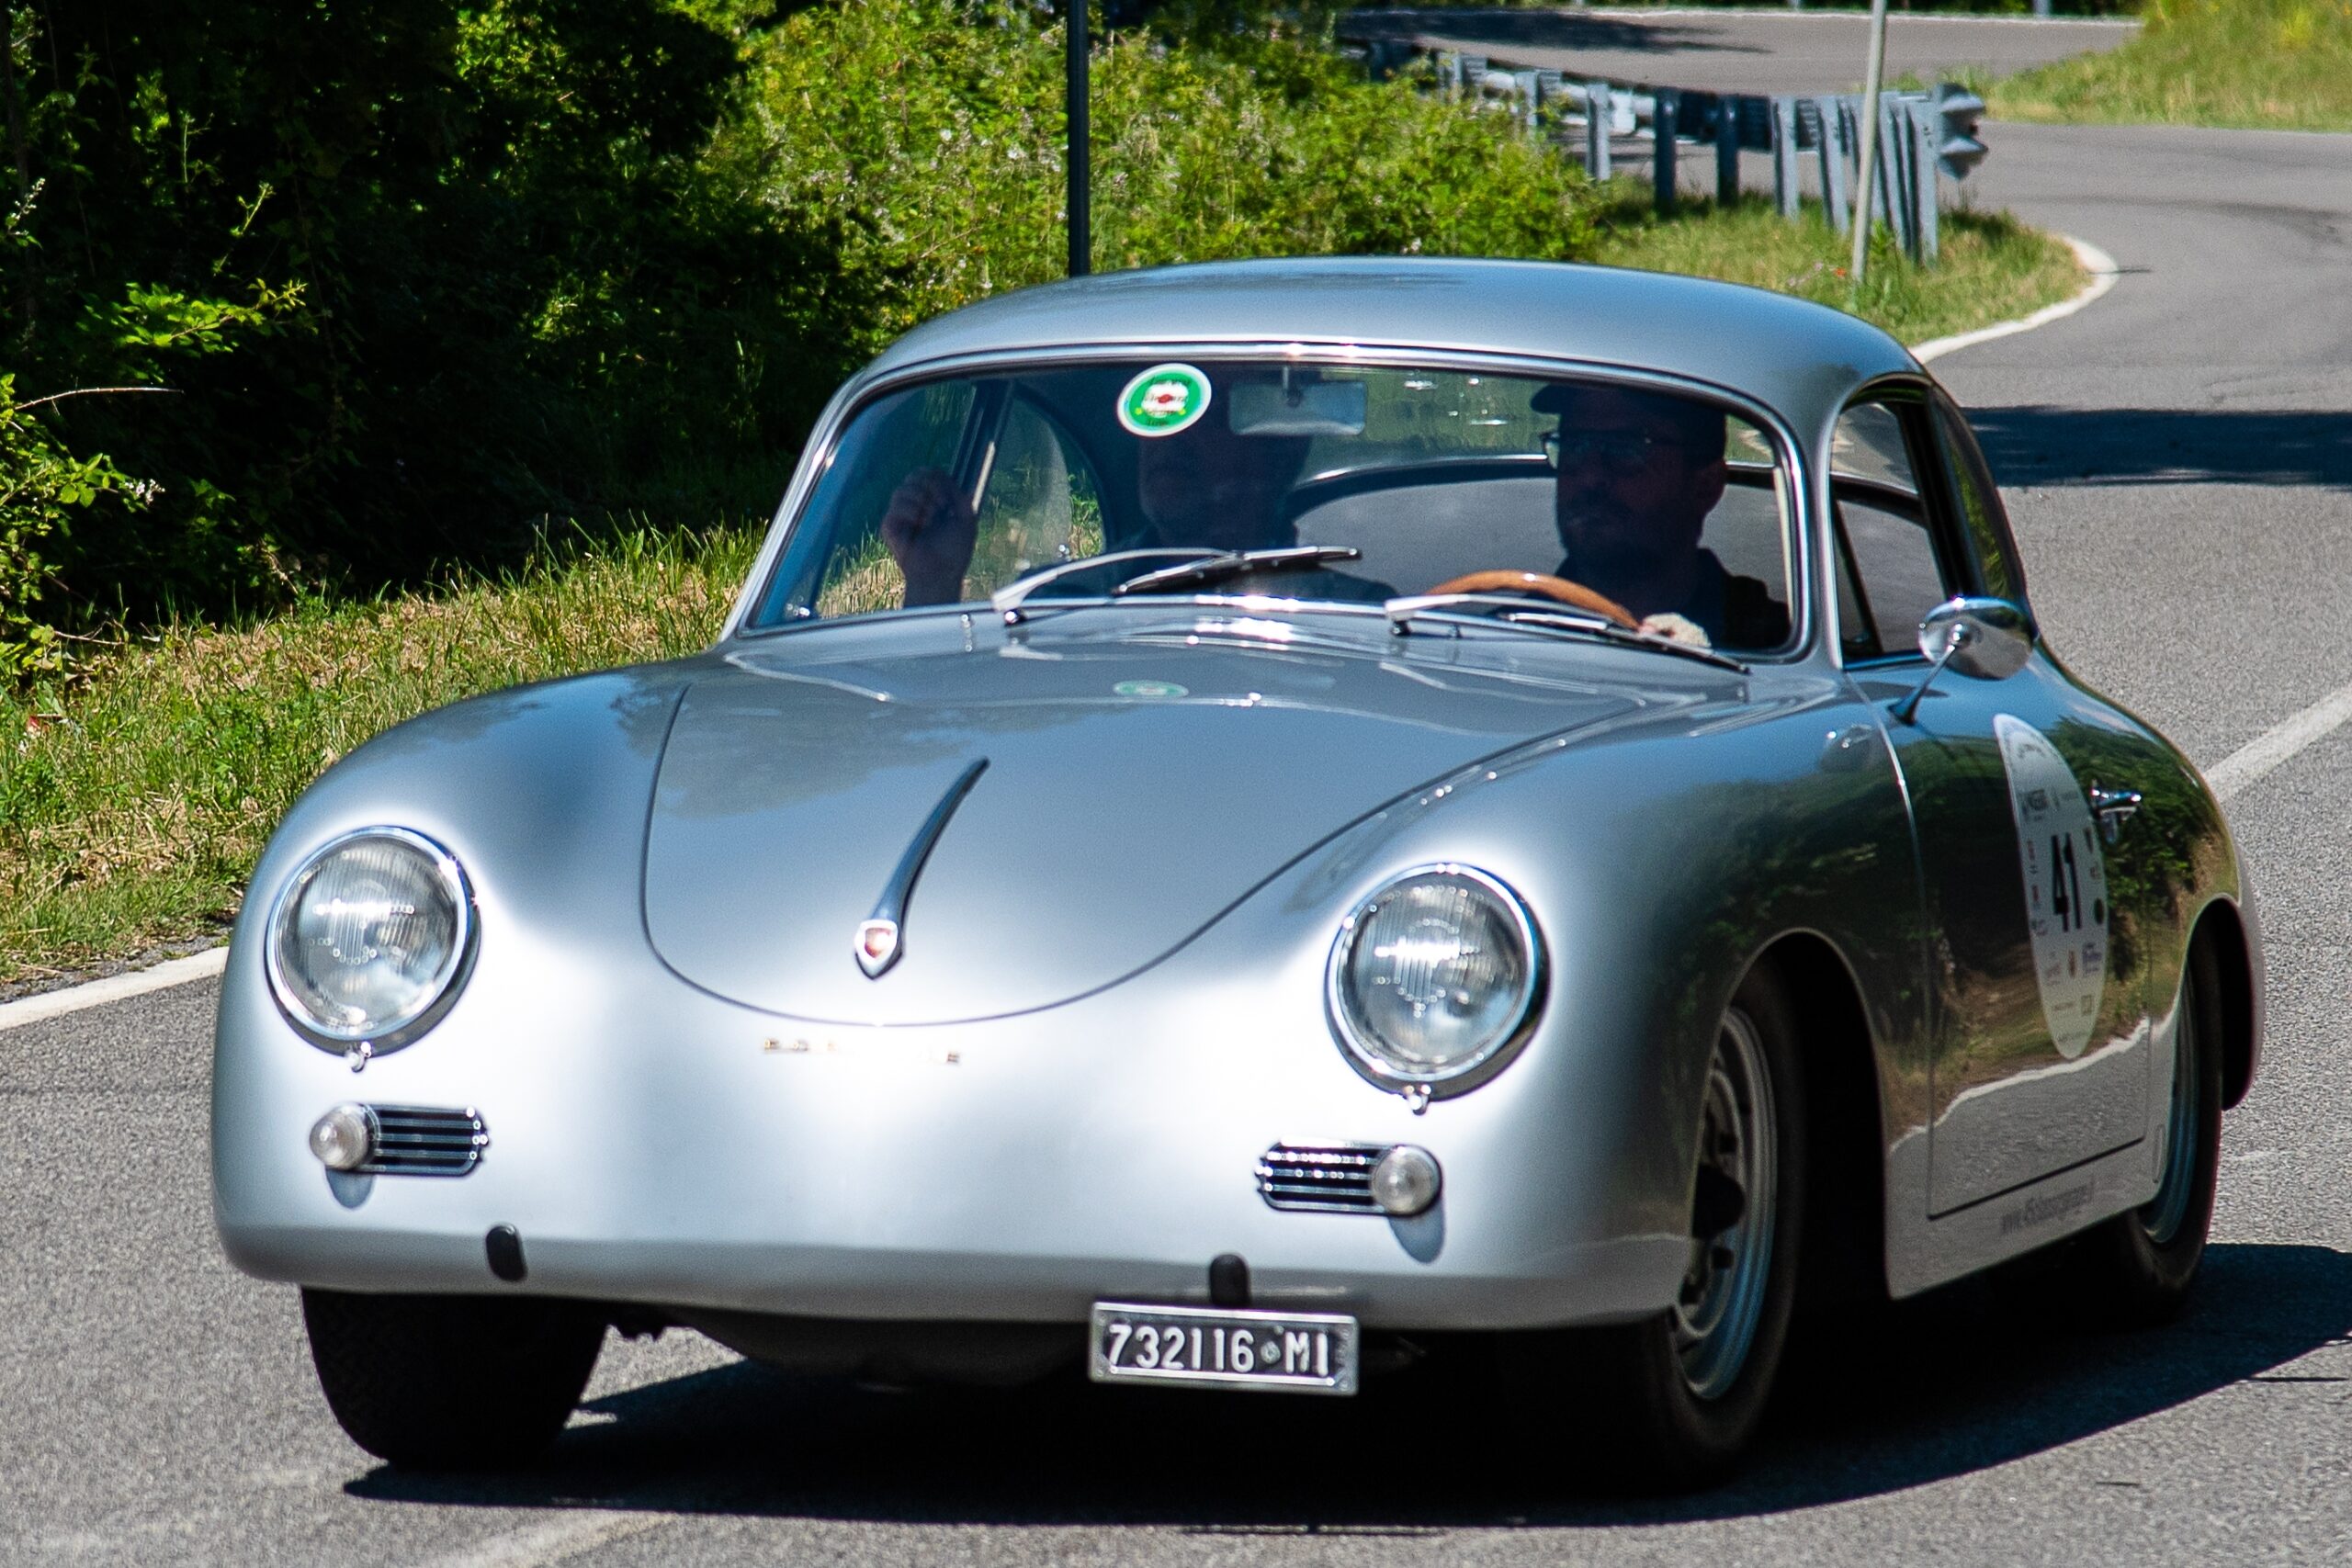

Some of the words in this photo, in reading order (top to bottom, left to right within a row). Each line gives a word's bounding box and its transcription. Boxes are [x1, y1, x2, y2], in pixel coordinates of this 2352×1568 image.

[2051, 832, 2081, 932] 41
[1109, 1325, 1255, 1372] 732116
[1285, 1332, 1329, 1377] MI
